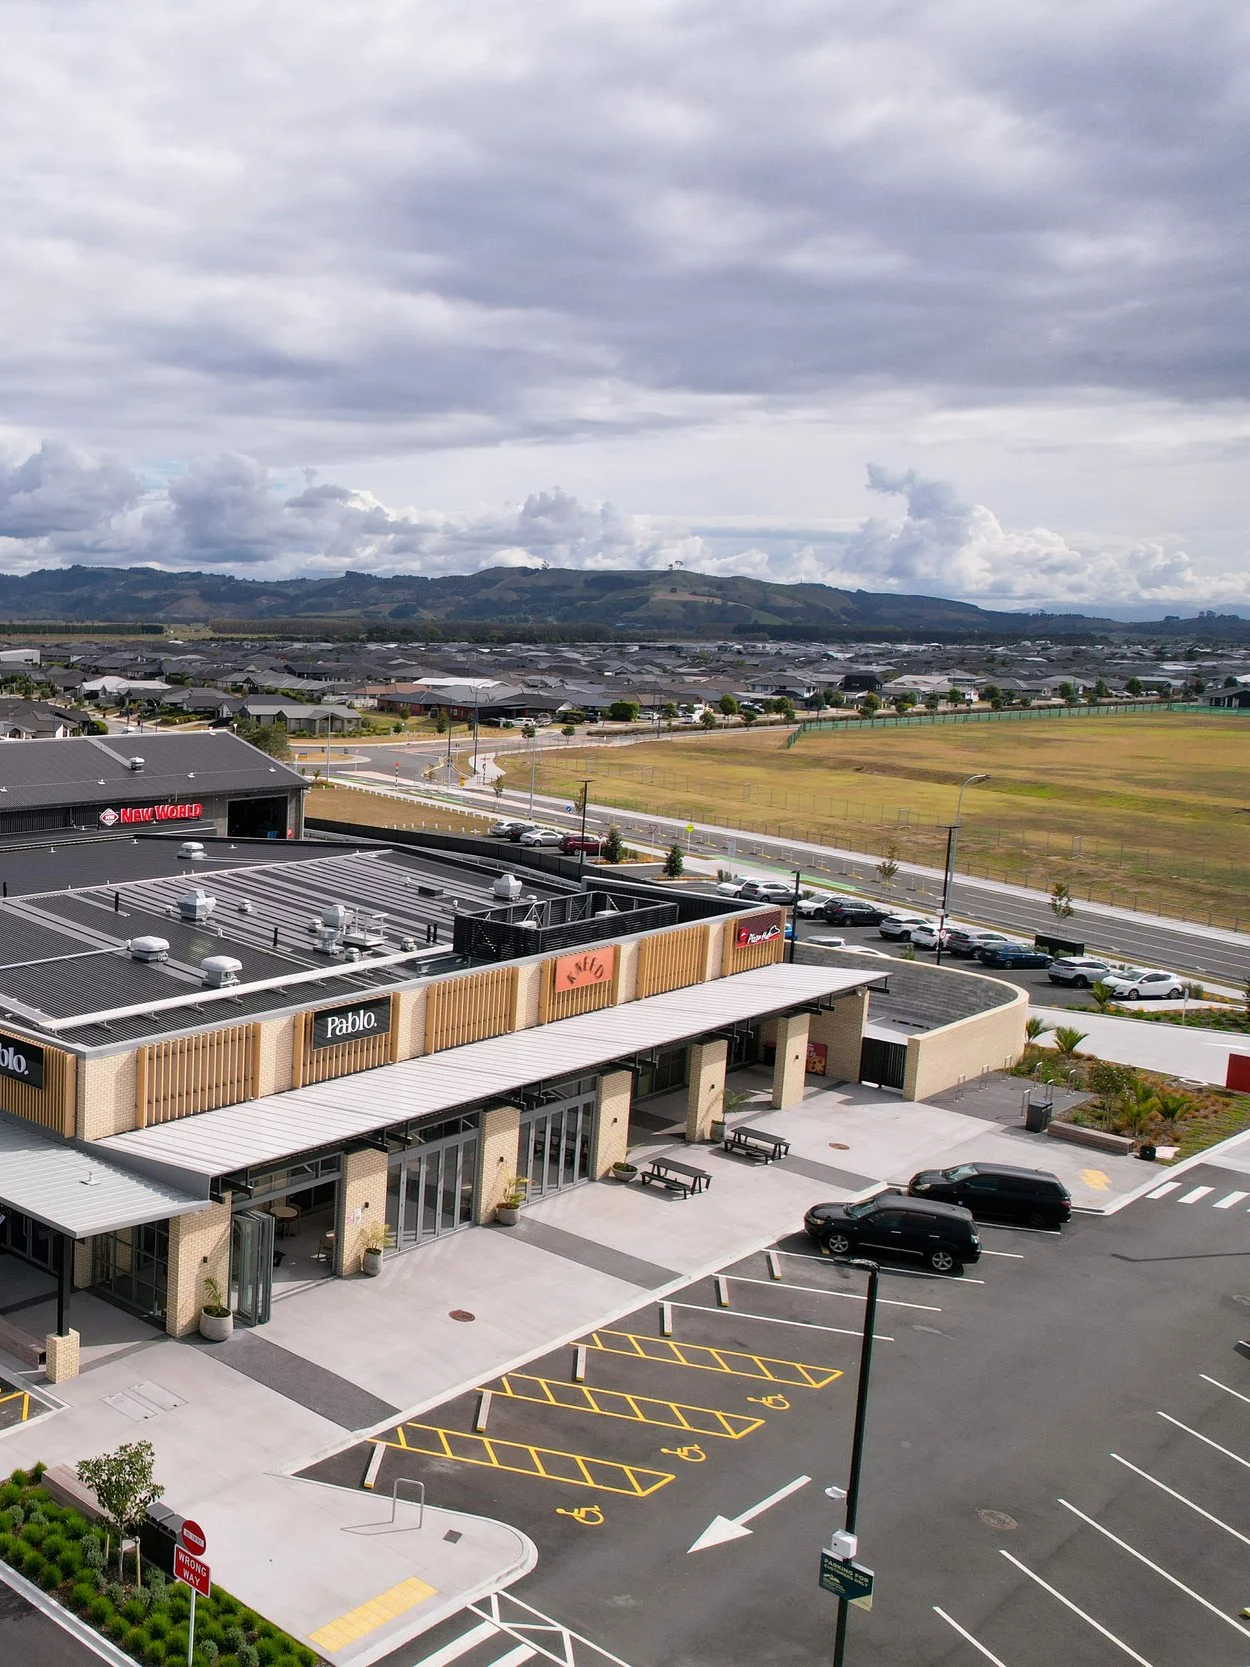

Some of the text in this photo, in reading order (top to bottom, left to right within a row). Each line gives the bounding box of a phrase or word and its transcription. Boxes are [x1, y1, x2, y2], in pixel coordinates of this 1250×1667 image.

[120, 803, 203, 824] NEW WORLD
[567, 955, 605, 985] KNEED
[326, 1009, 378, 1039] Pablo.
[178, 1551, 207, 1578] WRONG
[823, 1563, 854, 1581] CUSTOMERS
[854, 1578, 868, 1588] ONLY
[824, 1558, 869, 1583] PARKING FOR
[183, 1568, 201, 1587] WAY
